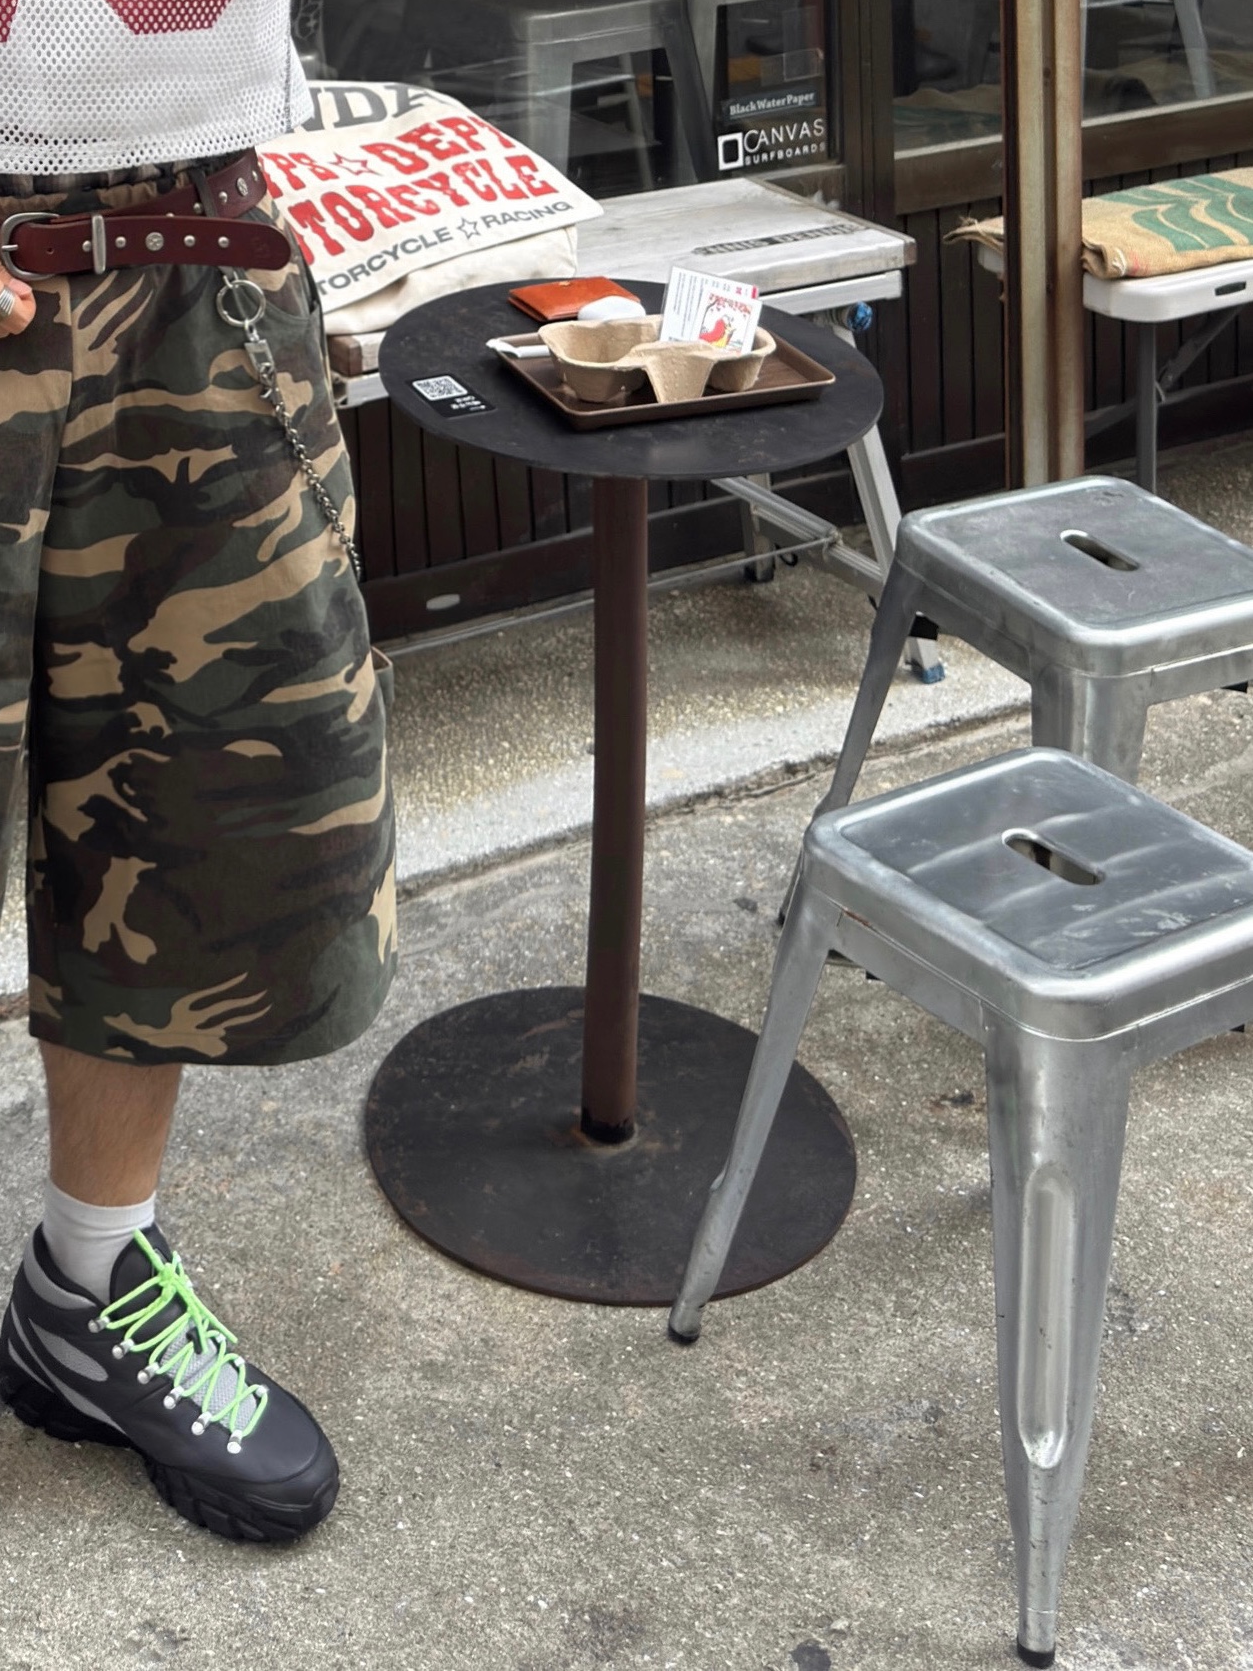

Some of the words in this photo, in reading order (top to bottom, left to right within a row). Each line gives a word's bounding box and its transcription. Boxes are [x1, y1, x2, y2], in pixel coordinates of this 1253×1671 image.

[360, 117, 516, 175] DEPT
[743, 118, 825, 153] CANVAS
[744, 142, 826, 166] SURFBOARDS
[480, 200, 574, 229] RACING
